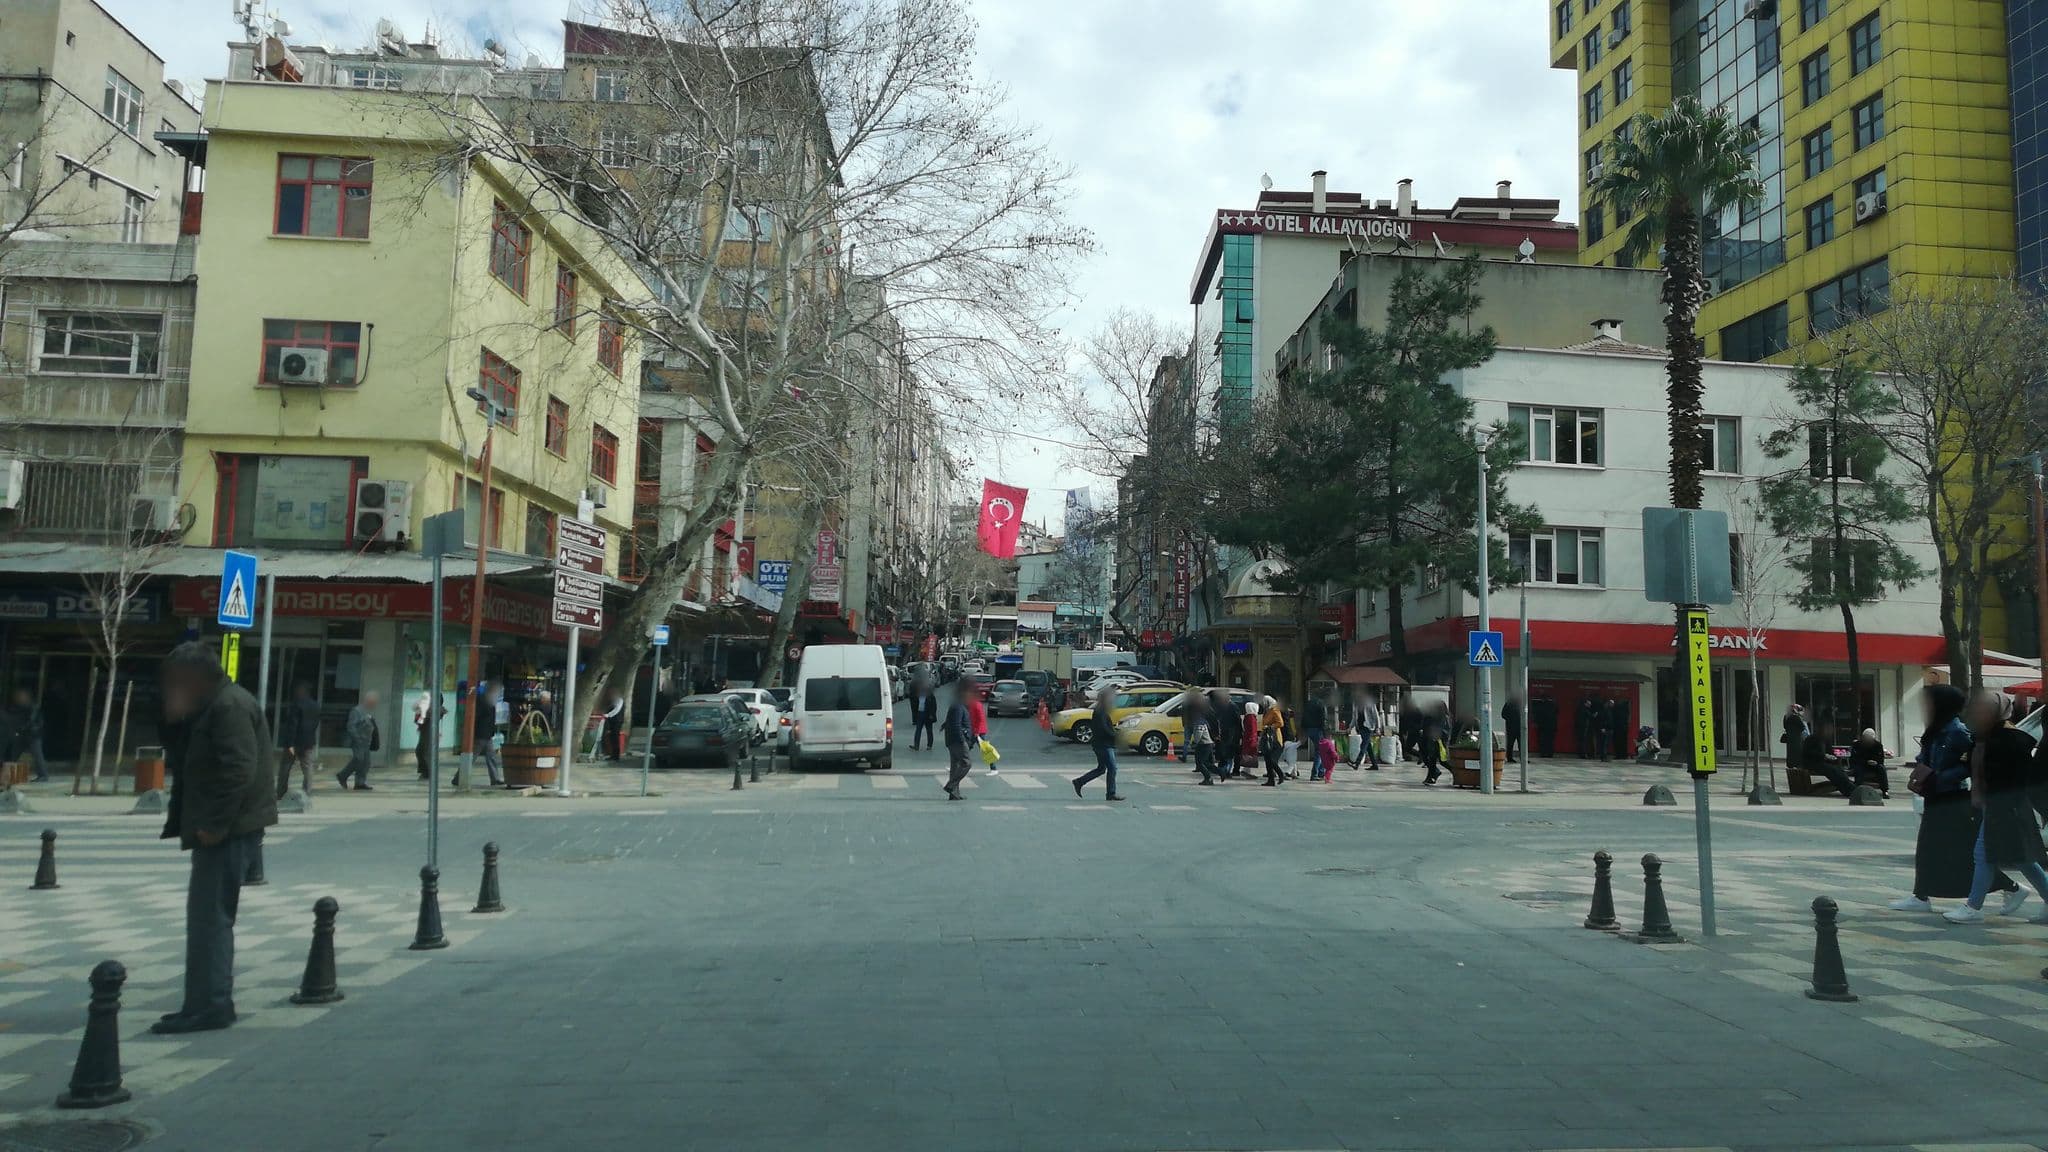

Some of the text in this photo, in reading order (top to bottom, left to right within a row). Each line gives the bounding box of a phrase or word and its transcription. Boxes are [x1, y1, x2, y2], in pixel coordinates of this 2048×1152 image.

[1265, 215, 1304, 232] OTEL
[821, 536, 833, 565] OTEL
[760, 562, 792, 574] OTE
[1671, 635, 1768, 650] BANK
[1695, 641, 1708, 766] YAYA GEÇİDİ
